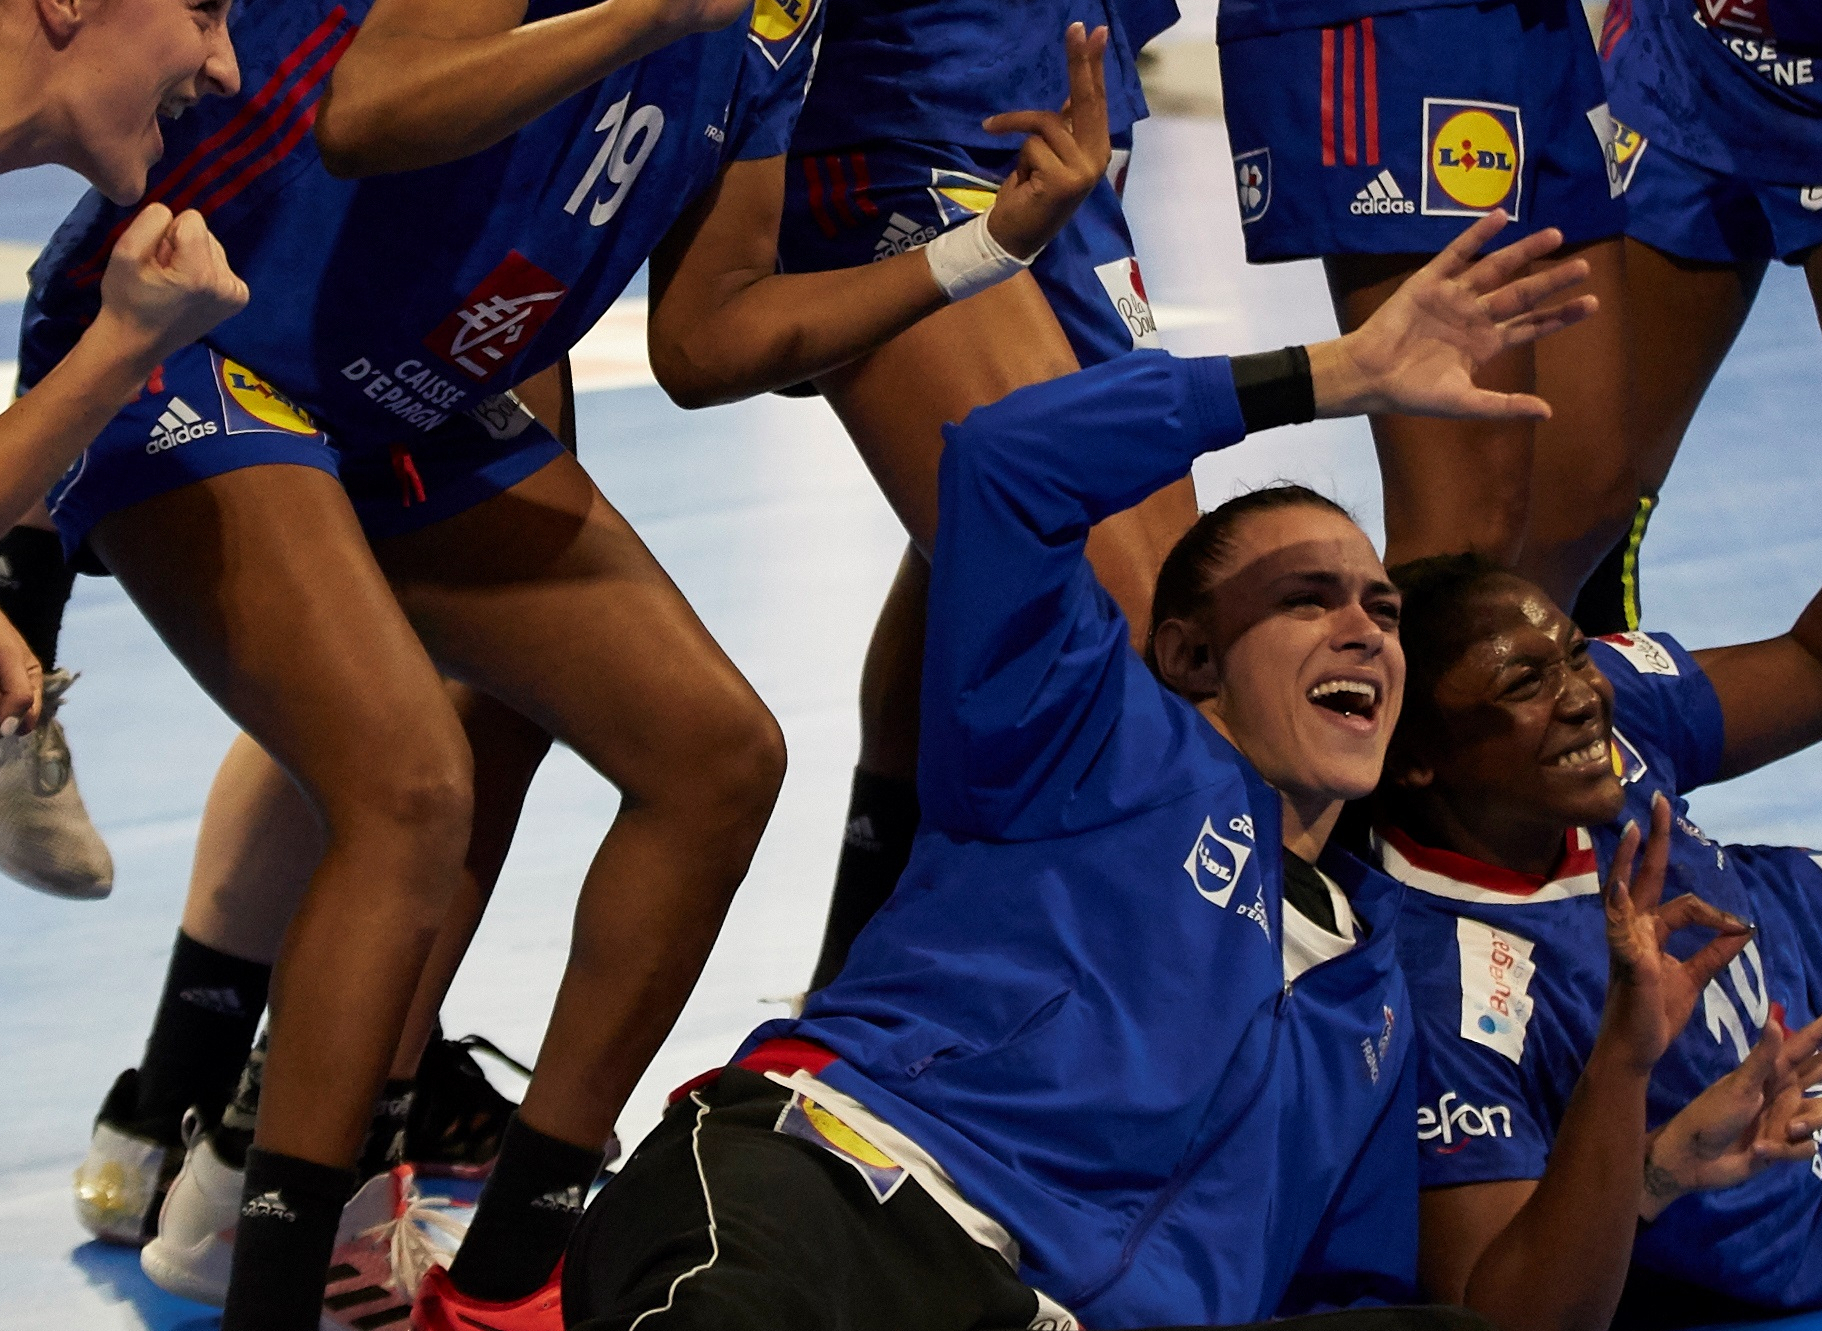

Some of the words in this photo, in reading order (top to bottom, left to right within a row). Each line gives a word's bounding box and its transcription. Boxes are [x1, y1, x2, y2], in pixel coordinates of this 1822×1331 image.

[563, 90, 665, 227] 19
[1350, 197, 1415, 214] adidas
[394, 360, 467, 410] CAISSE
[146, 418, 218, 455] adidas
